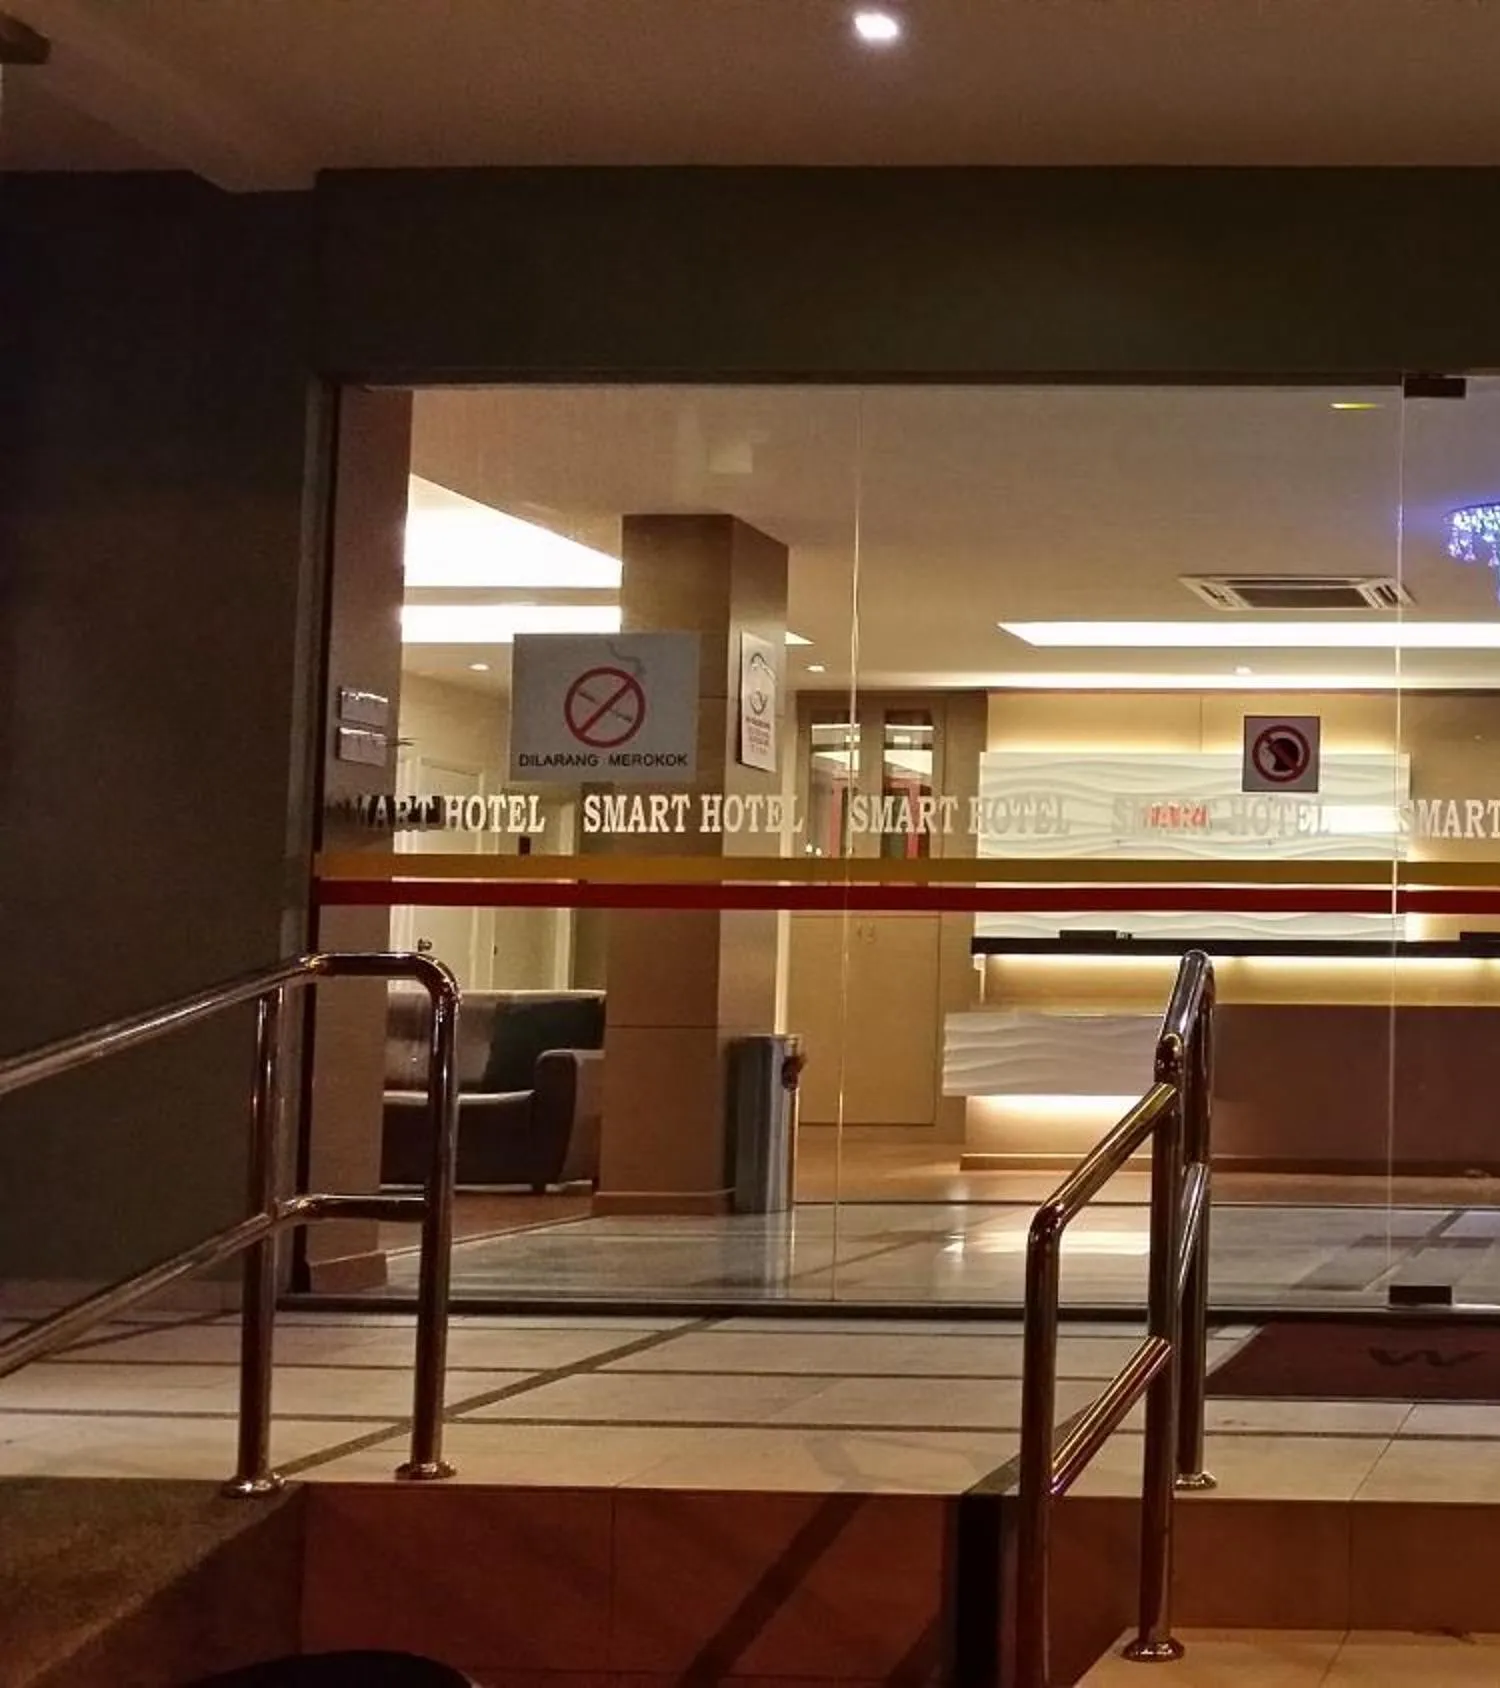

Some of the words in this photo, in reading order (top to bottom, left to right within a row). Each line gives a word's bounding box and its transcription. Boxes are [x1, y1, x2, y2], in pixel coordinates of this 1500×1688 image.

[518, 752, 599, 768] DILARANG
[608, 753, 689, 769] MEROKOK
[334, 795, 436, 833] MART
[443, 795, 546, 833] HOTEL
[583, 794, 691, 833] SMART
[700, 794, 803, 834] HOTEL
[850, 796, 959, 834] SMART
[968, 795, 1070, 835] HOTEL
